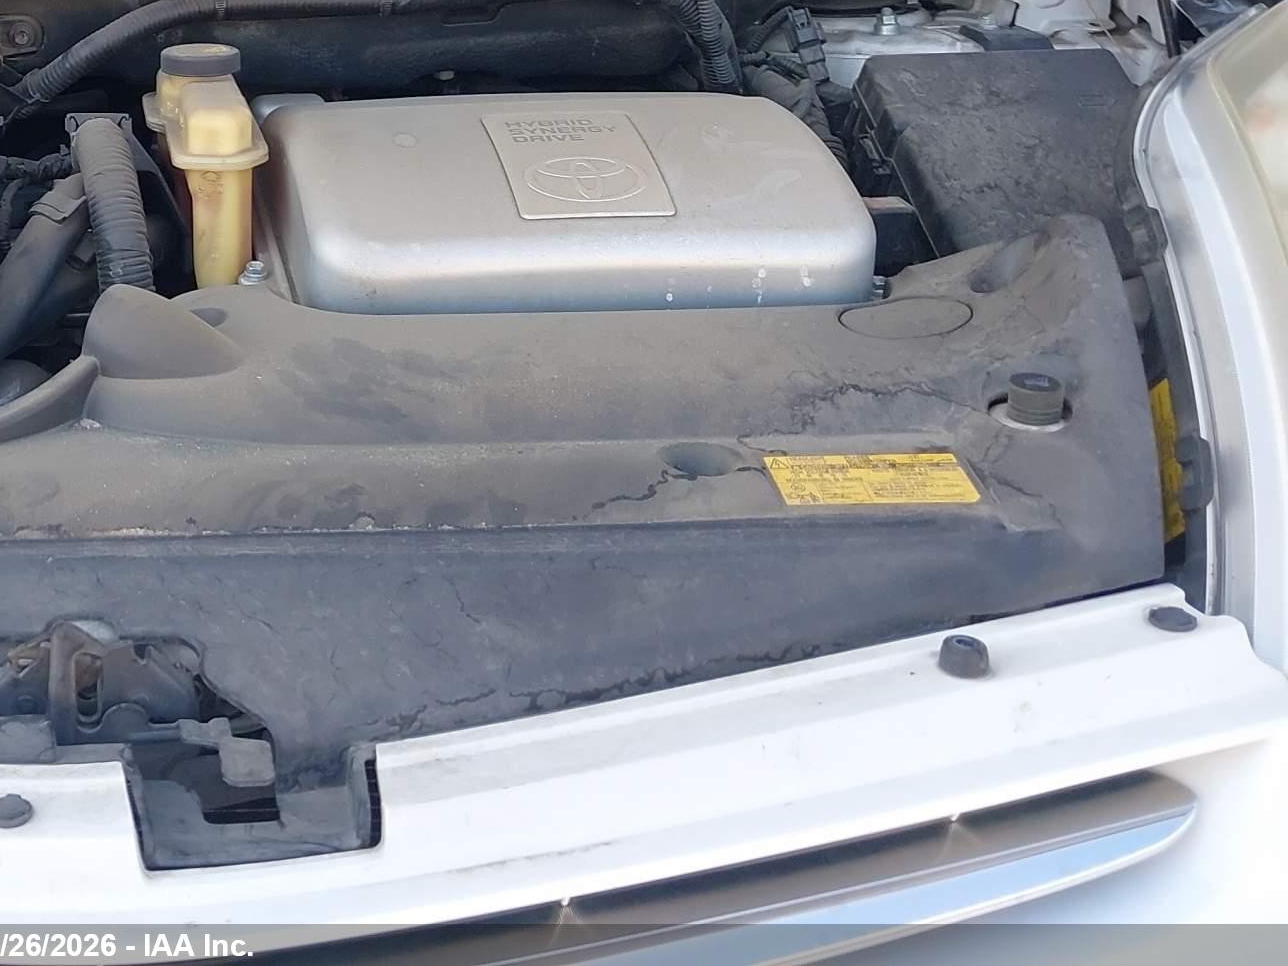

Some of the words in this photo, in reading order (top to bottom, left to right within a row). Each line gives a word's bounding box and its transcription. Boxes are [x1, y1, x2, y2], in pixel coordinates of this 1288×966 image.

[504, 119, 592, 128] HYBRID
[509, 125, 616, 136] SYNERGY
[512, 134, 584, 143] DRIVE
